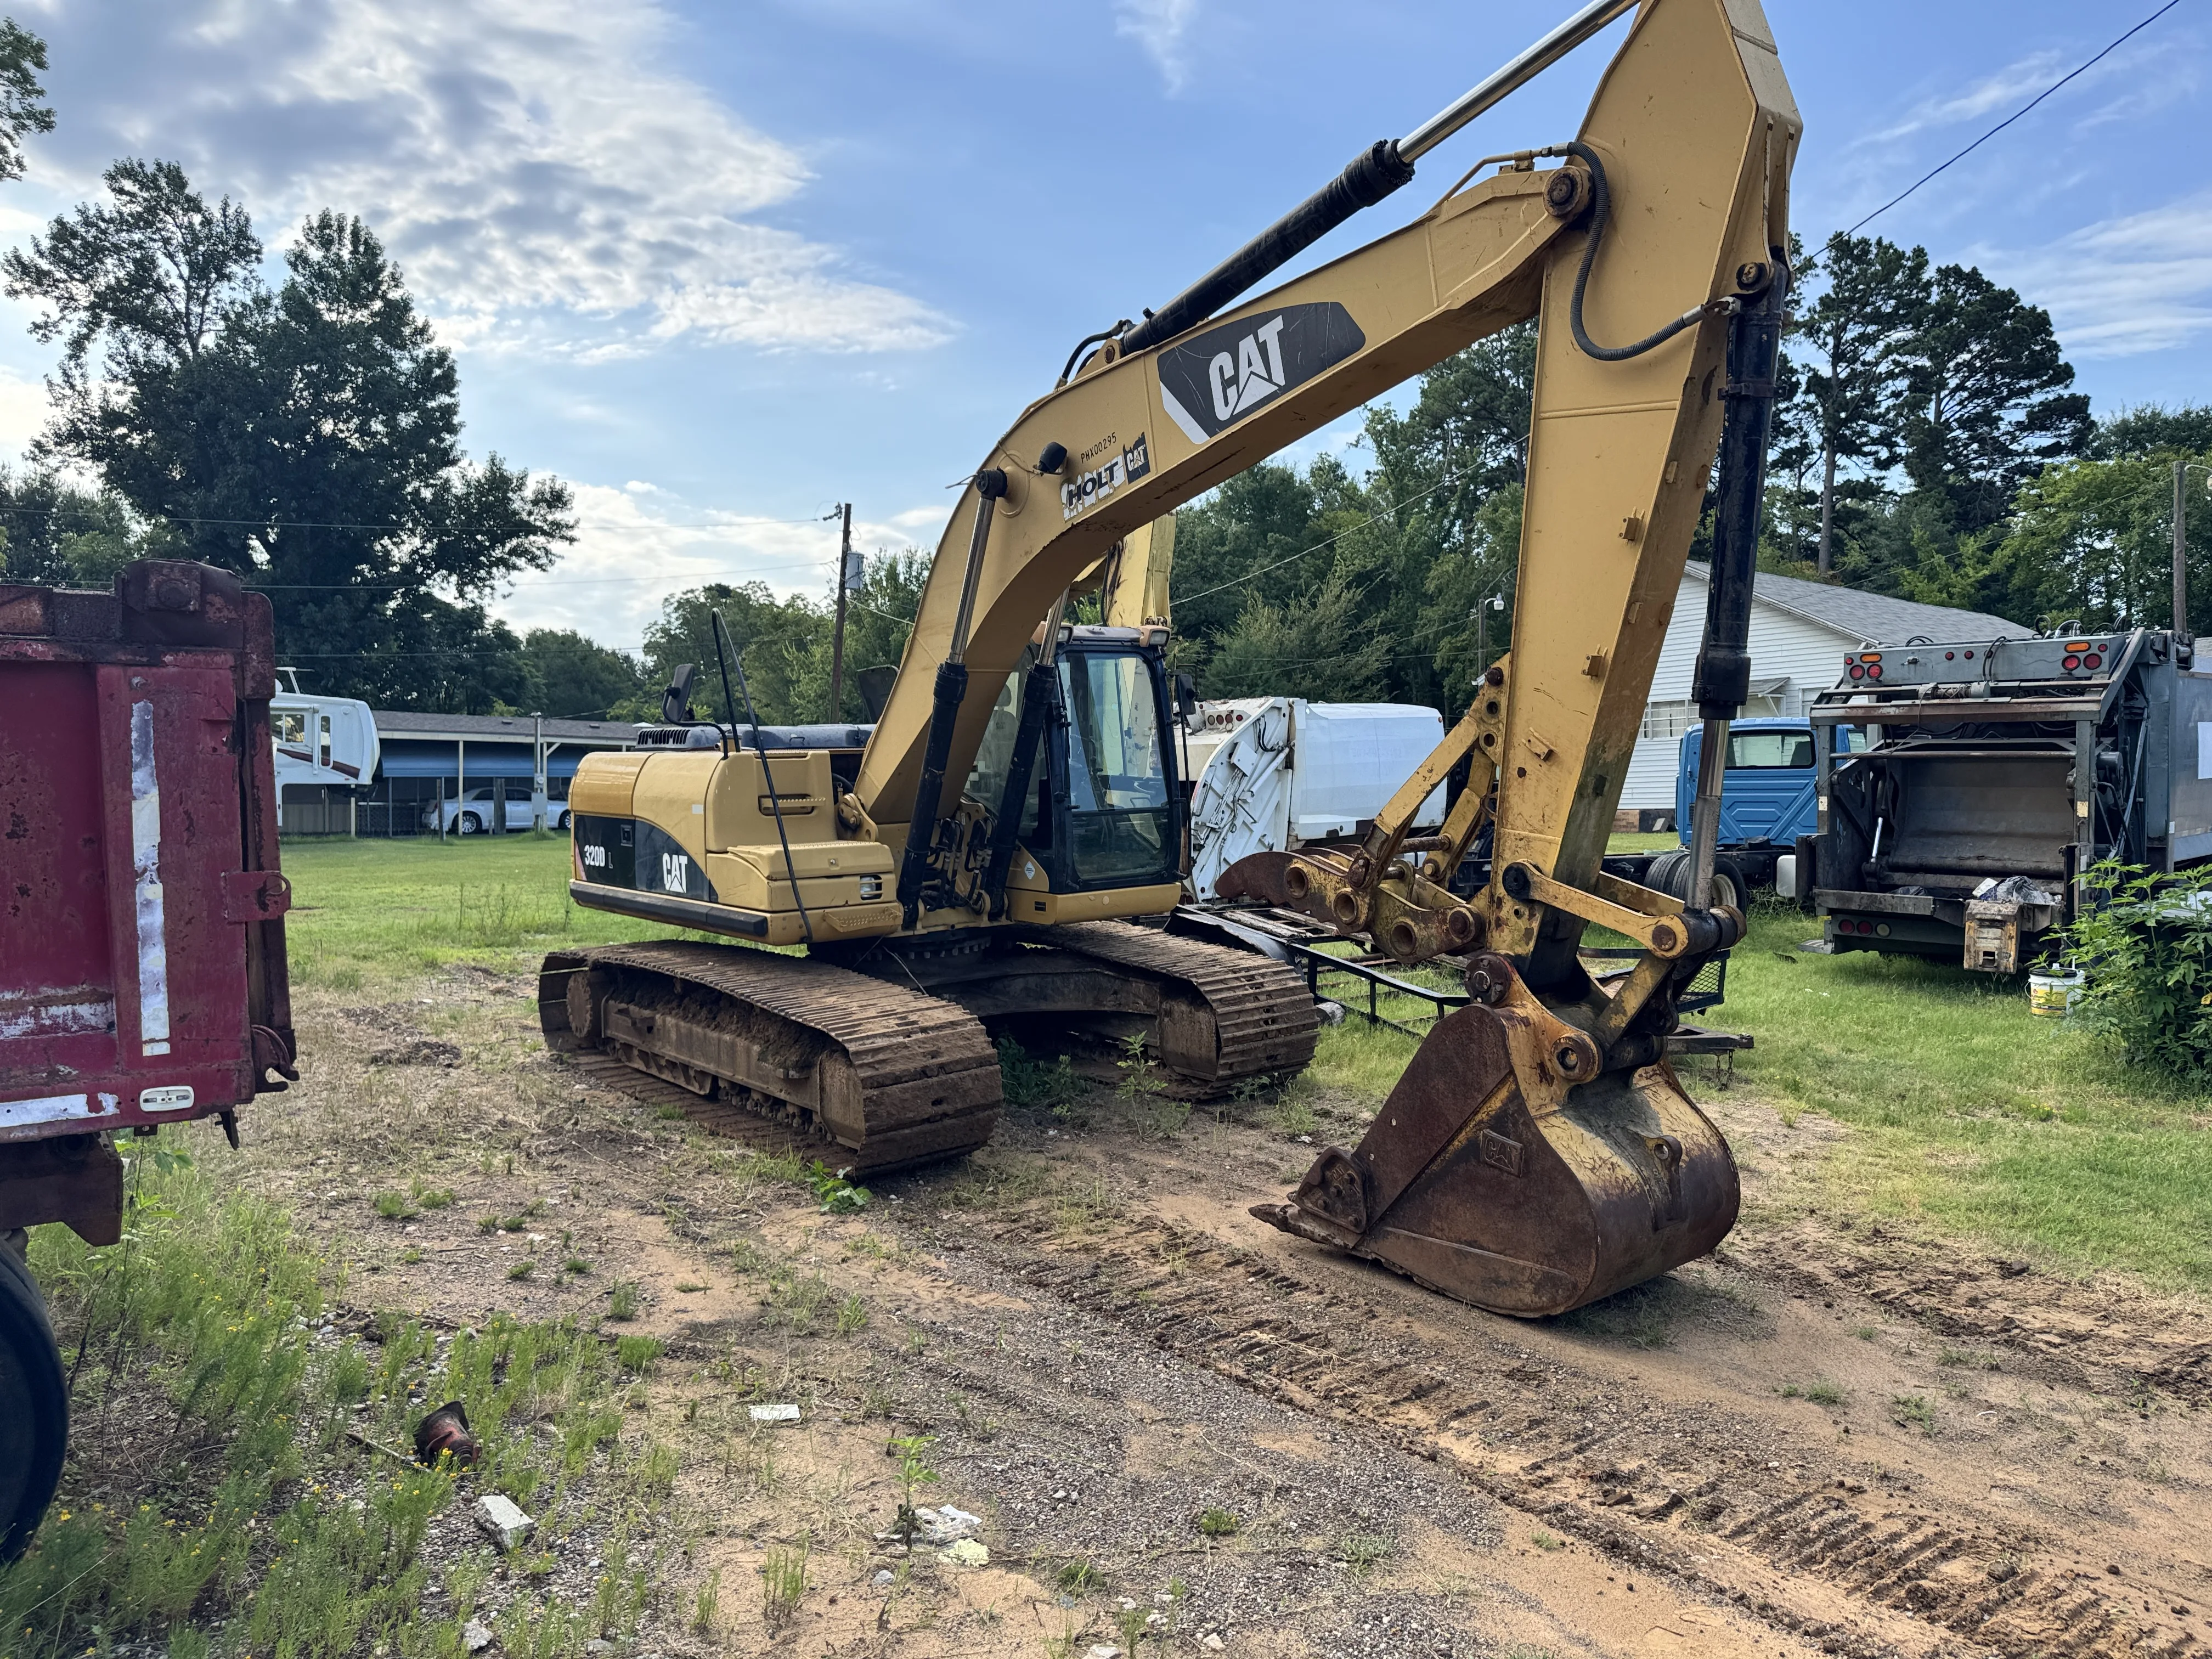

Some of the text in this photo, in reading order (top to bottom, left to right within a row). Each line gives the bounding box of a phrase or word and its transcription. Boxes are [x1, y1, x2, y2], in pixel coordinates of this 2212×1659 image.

[1209, 315, 1285, 421] CAT
[1081, 432, 1116, 464] PHX00295
[1068, 445, 1145, 507] HOLT CAT
[584, 844, 605, 867] 320D
[662, 853, 688, 893] CAT
[1485, 1136, 1519, 1173] CAT
